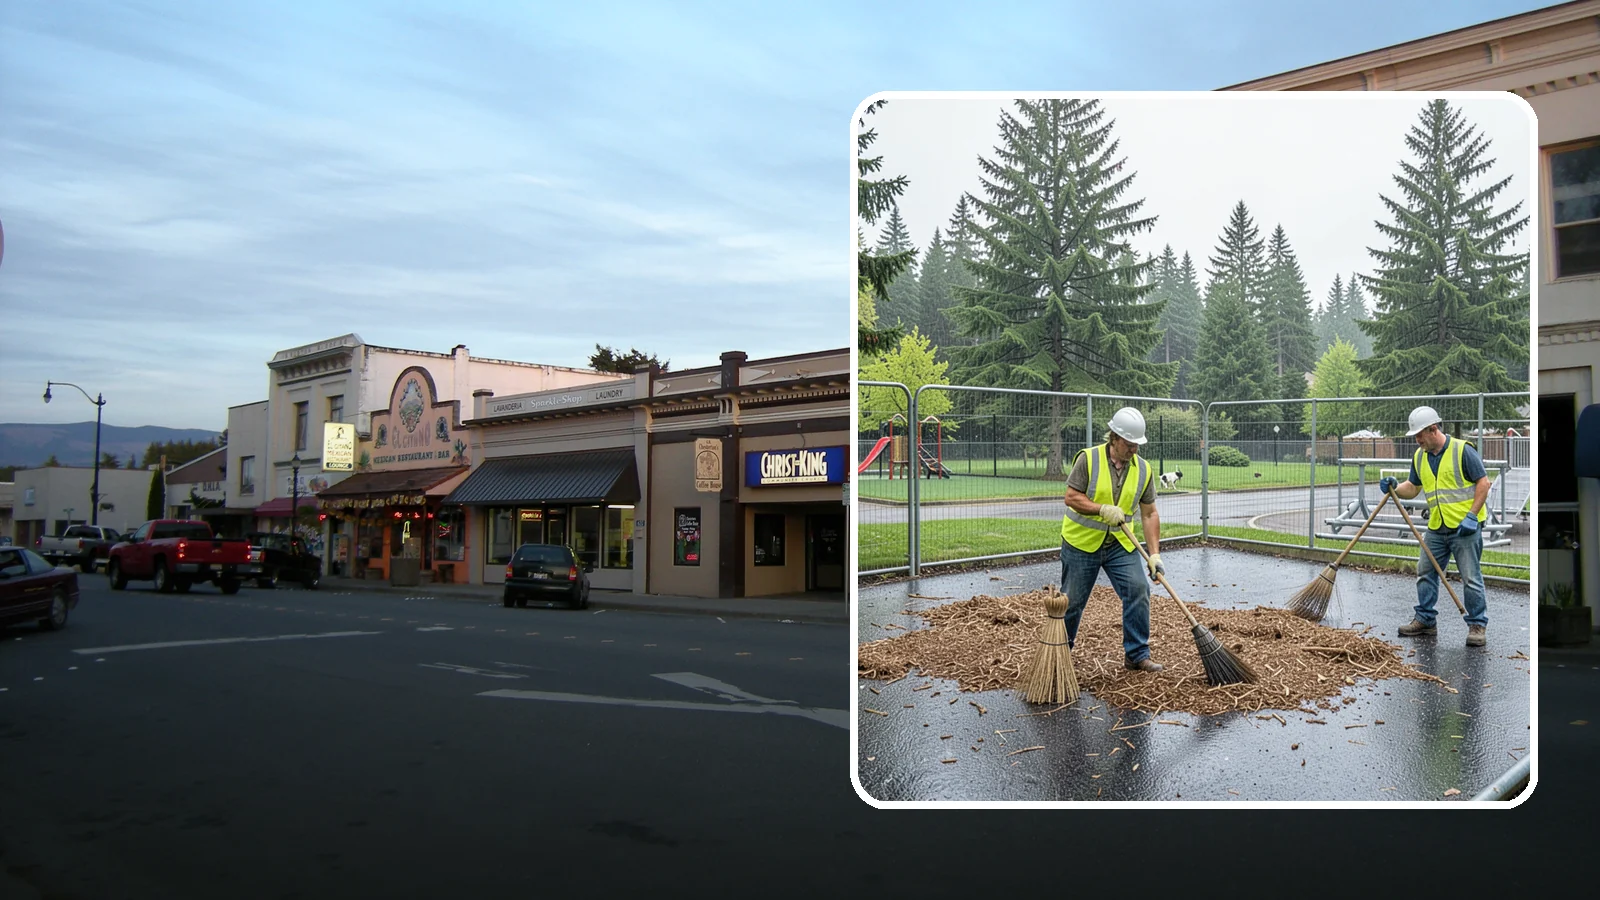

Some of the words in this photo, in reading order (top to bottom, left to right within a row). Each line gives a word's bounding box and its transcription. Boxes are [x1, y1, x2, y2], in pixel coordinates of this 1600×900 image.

[595, 389, 623, 400] LAUNDRY
[493, 402, 523, 413] LAVANDERIA
[373, 454, 396, 464] MEXICAN
[397, 451, 434, 462] RESTAURANT
[437, 450, 450, 458] BAR
[761, 452, 797, 477] CHRIST
[800, 450, 827, 476] KING
